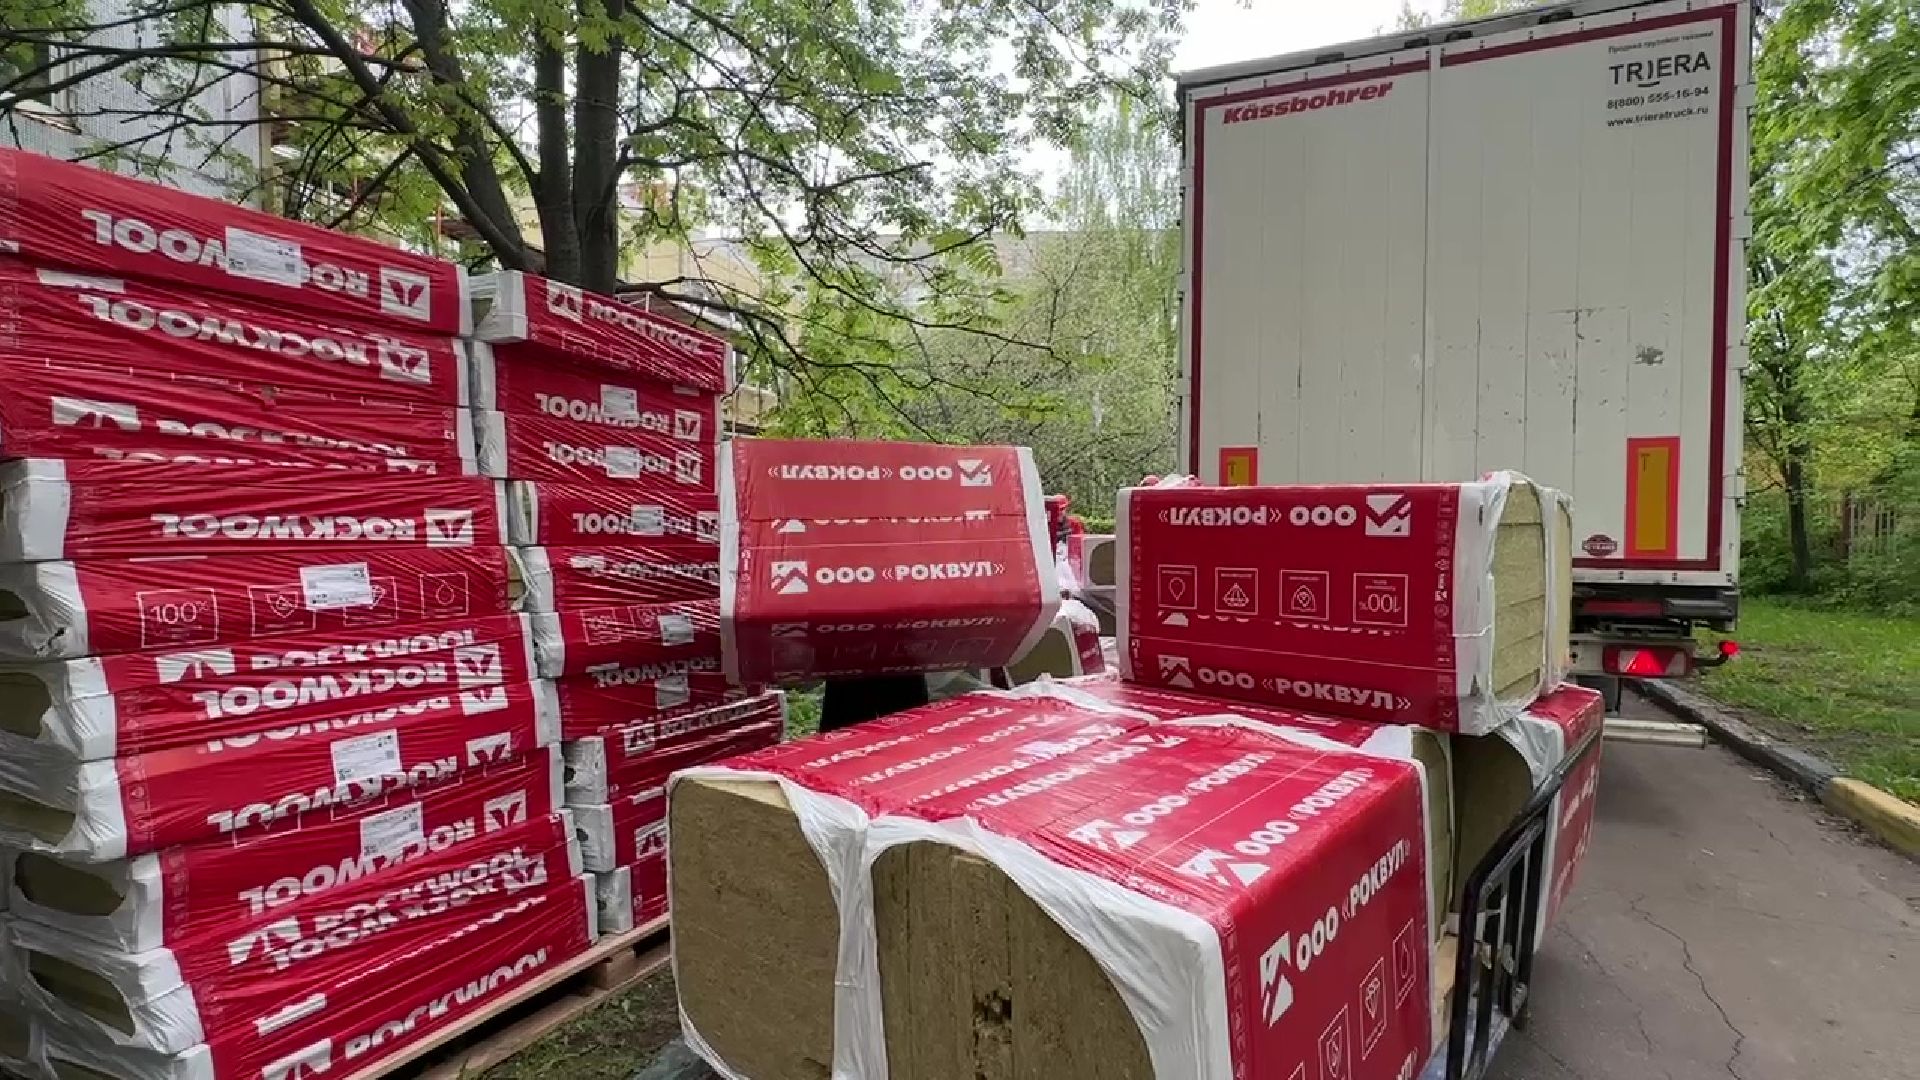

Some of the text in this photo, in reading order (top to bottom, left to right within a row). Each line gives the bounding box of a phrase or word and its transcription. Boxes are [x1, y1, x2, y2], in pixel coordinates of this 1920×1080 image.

[1608, 51, 1711, 87] TRIERA
[1223, 81, 1393, 124] Kässbohrer
[1607, 86, 1709, 110] 8(800) 555-16-94
[1607, 107, 1709, 127] www.trieratruck.ru
[78, 294, 371, 366] ROCKWOOL
[768, 464, 953, 481] ООО «РОКВУЛ»
[150, 513, 417, 541] ROCKWOOL
[1158, 504, 1357, 527] ООО «РОКВУЛ»
[815, 560, 1006, 584] ООО «РОКВУЛ»
[193, 661, 448, 719] ROCKWOOL
[1198, 667, 1255, 690] ООО
[1262, 677, 1411, 711] «РОКВУЛ»
[1123, 795, 1189, 826] ООО
[1234, 767, 1375, 856] ООО «РОКВУЛ»
[1296, 838, 1411, 972] ООО «РОКВУЛ»
